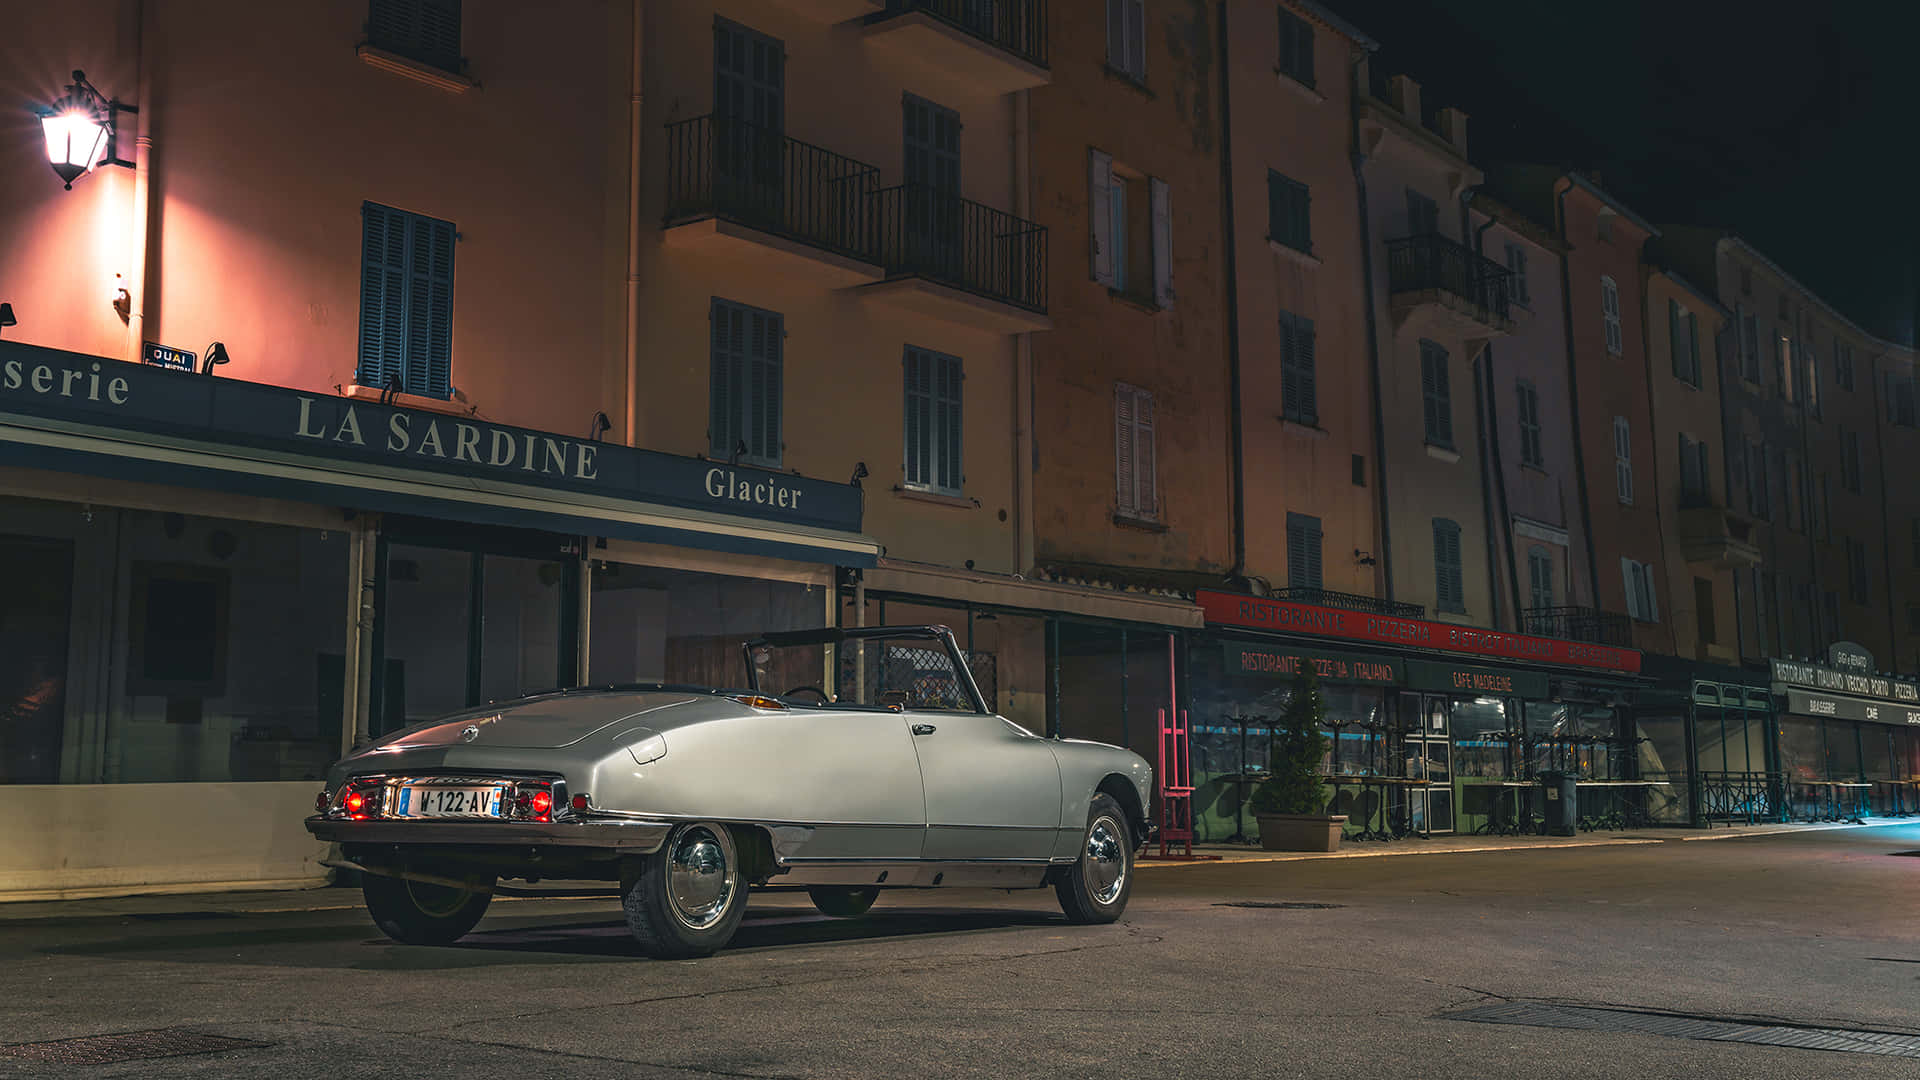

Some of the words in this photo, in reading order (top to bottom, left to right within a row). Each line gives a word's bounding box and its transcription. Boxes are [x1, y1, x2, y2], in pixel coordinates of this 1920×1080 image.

[153, 349, 186, 365] QUAI
[4, 360, 129, 405] serie
[295, 396, 366, 446] LA
[387, 412, 599, 480] SARDINE
[705, 468, 802, 509] Glacier
[1239, 601, 1345, 631] RISTORANTE
[1367, 618, 1431, 642] PIZZERIA
[1449, 629, 1502, 650] BISTROT
[1503, 637, 1553, 657] ITALIANO
[1241, 651, 1302, 675] RISTORANTE
[1353, 662, 1393, 681] ITALIANO
[1776, 663, 1815, 686] RISTORANTE
[1816, 669, 1844, 690] ITALIANO
[1845, 673, 1869, 694] VECCHIO
[1871, 678, 1889, 697] PORTO
[1895, 681, 1919, 701] PIZZERIA
